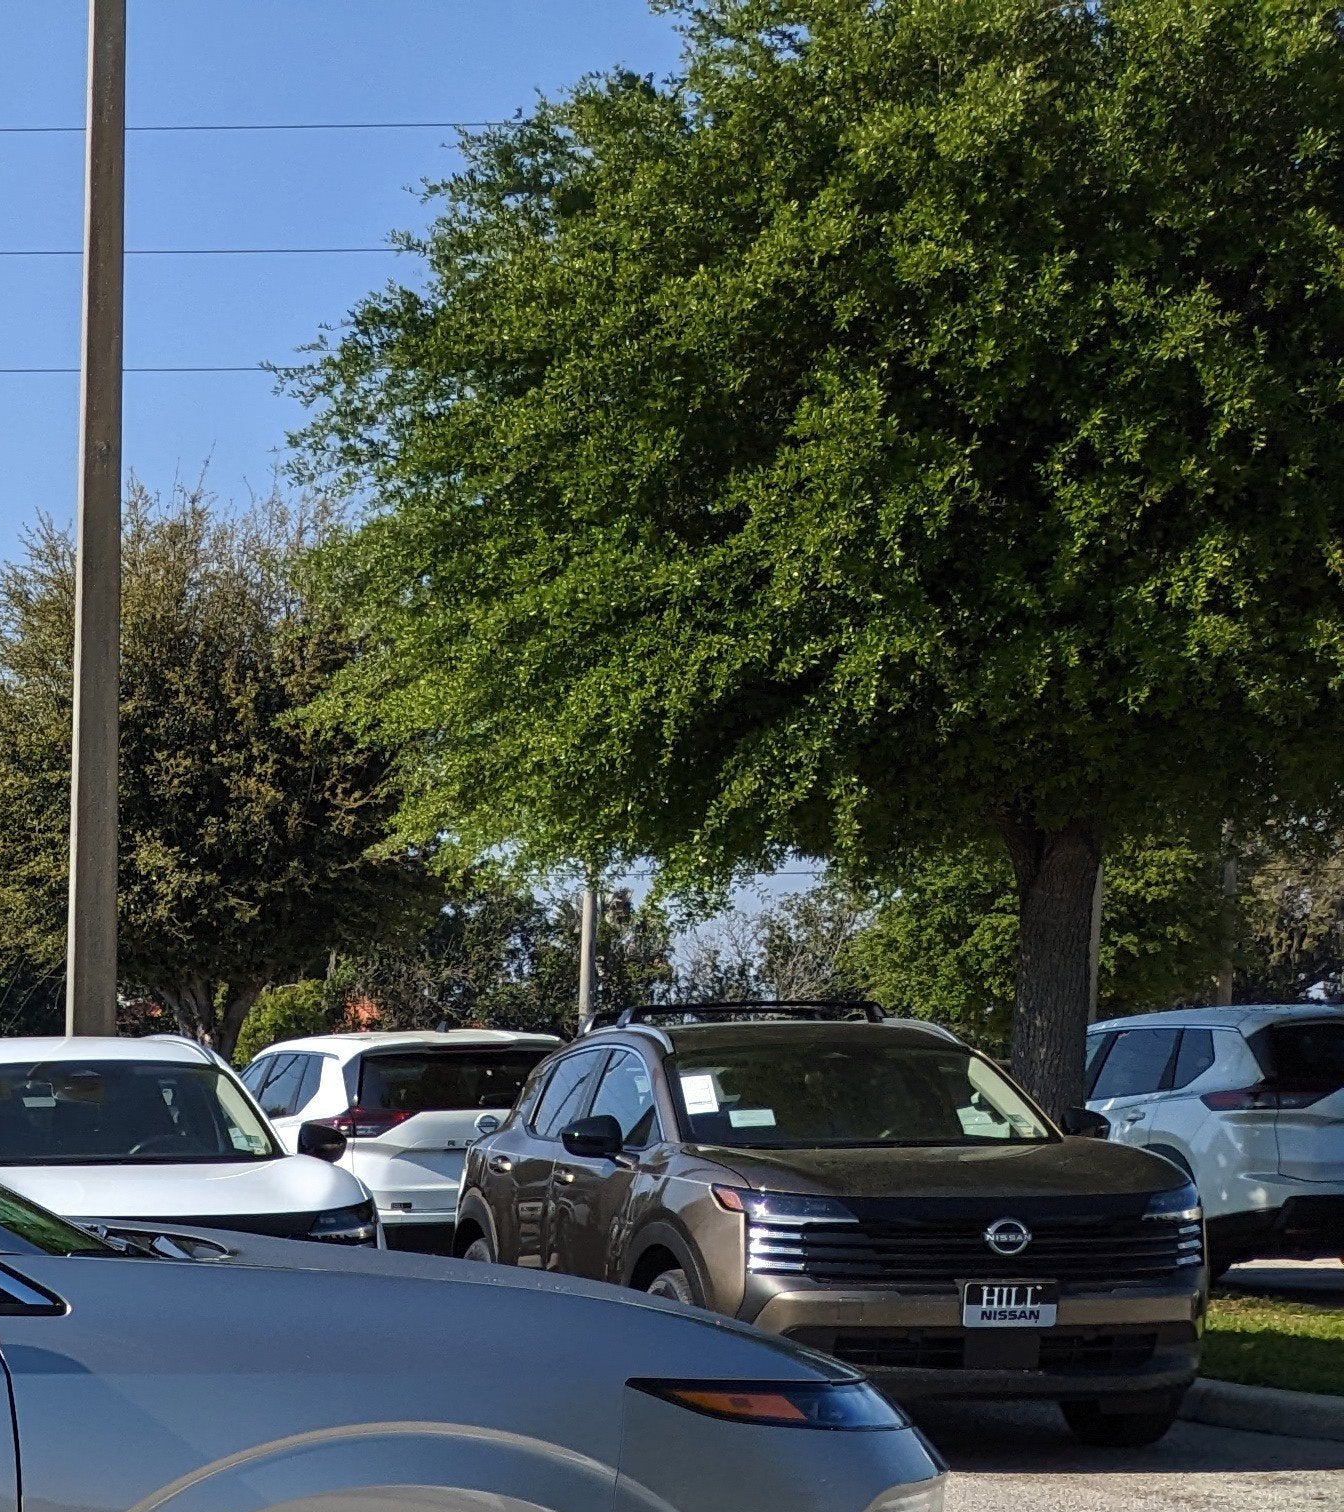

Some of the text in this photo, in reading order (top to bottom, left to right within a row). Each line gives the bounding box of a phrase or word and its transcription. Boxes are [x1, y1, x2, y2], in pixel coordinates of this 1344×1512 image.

[985, 1233, 1032, 1242] NISSAN
[981, 1286, 1041, 1309] HILL
[980, 1309, 1041, 1322] NISSAN
